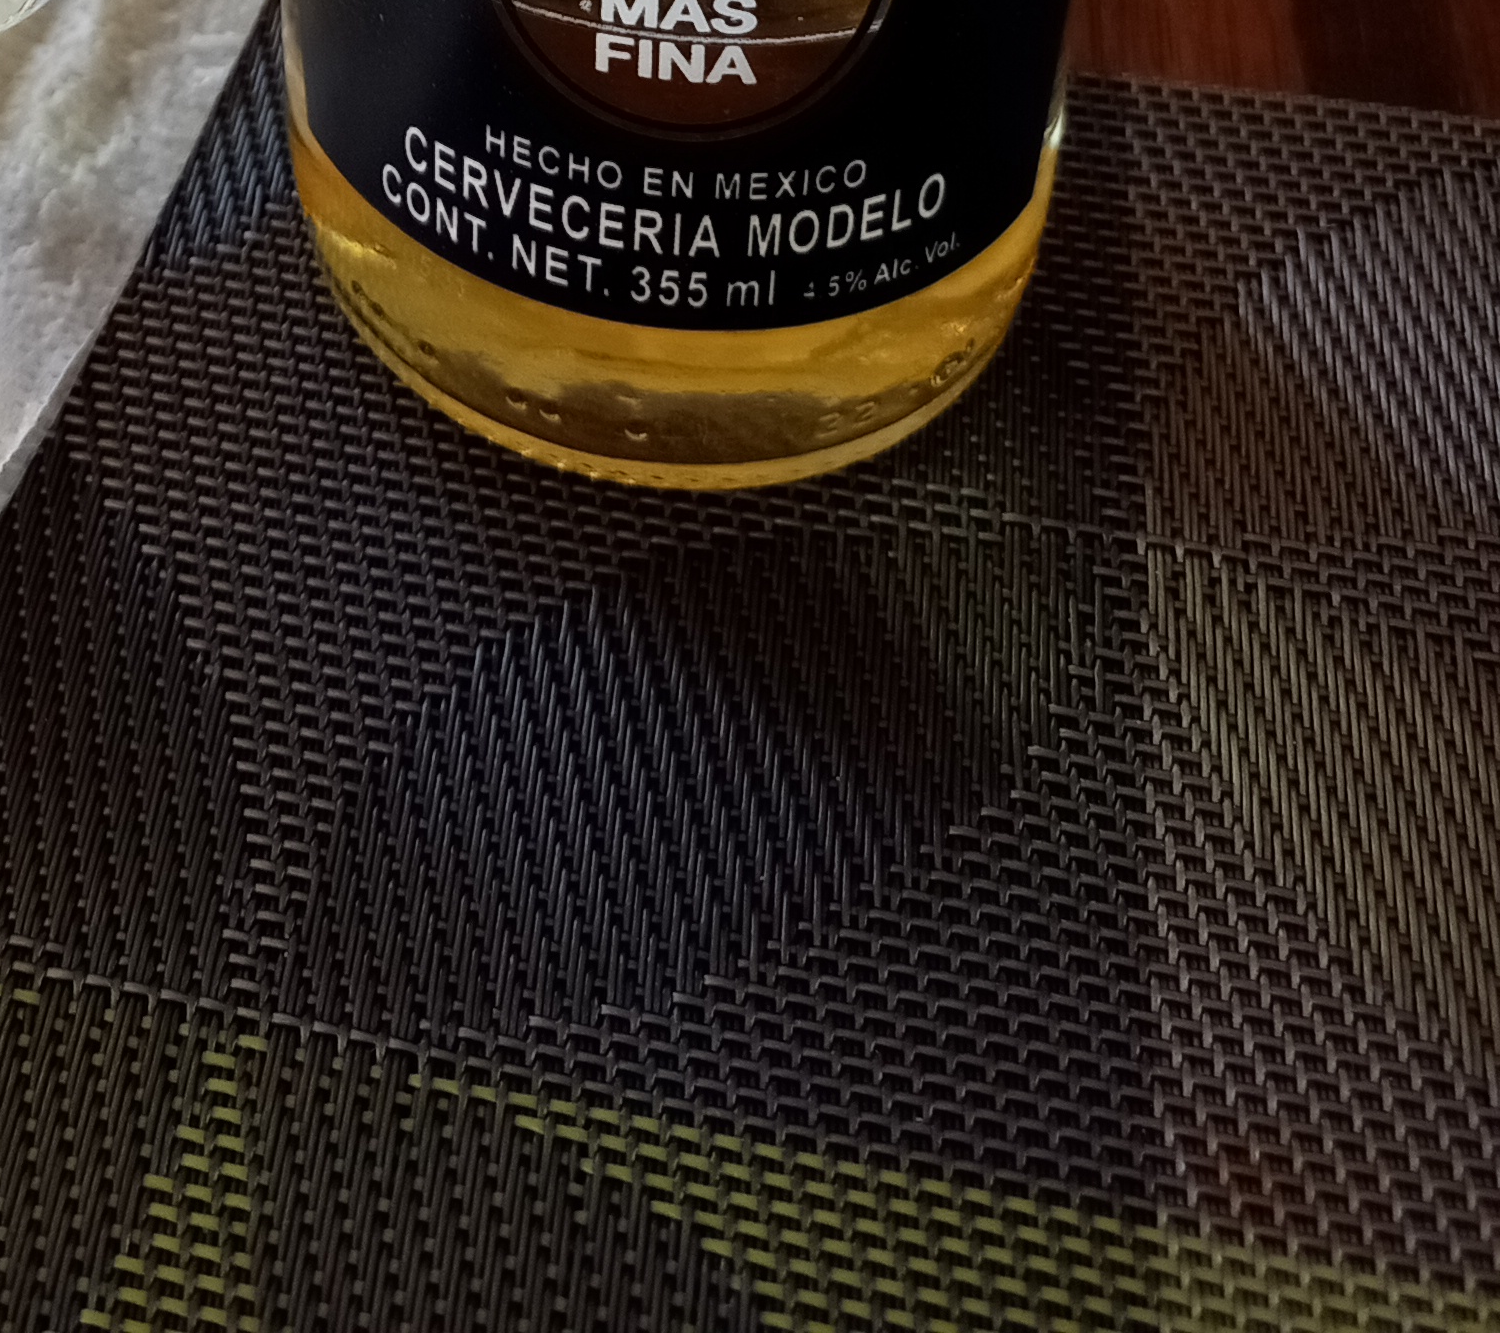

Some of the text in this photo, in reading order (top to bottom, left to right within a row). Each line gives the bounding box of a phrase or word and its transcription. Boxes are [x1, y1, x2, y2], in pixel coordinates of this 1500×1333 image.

[594, 32, 757, 85] FINA
[404, 126, 946, 259] CERVECERIA MODELO
[484, 124, 867, 201] HECHO EN MEXICO
[381, 163, 494, 261] CONT.
[511, 233, 610, 297] NET.
[629, 265, 708, 309] 355
[725, 269, 777, 308] ml
